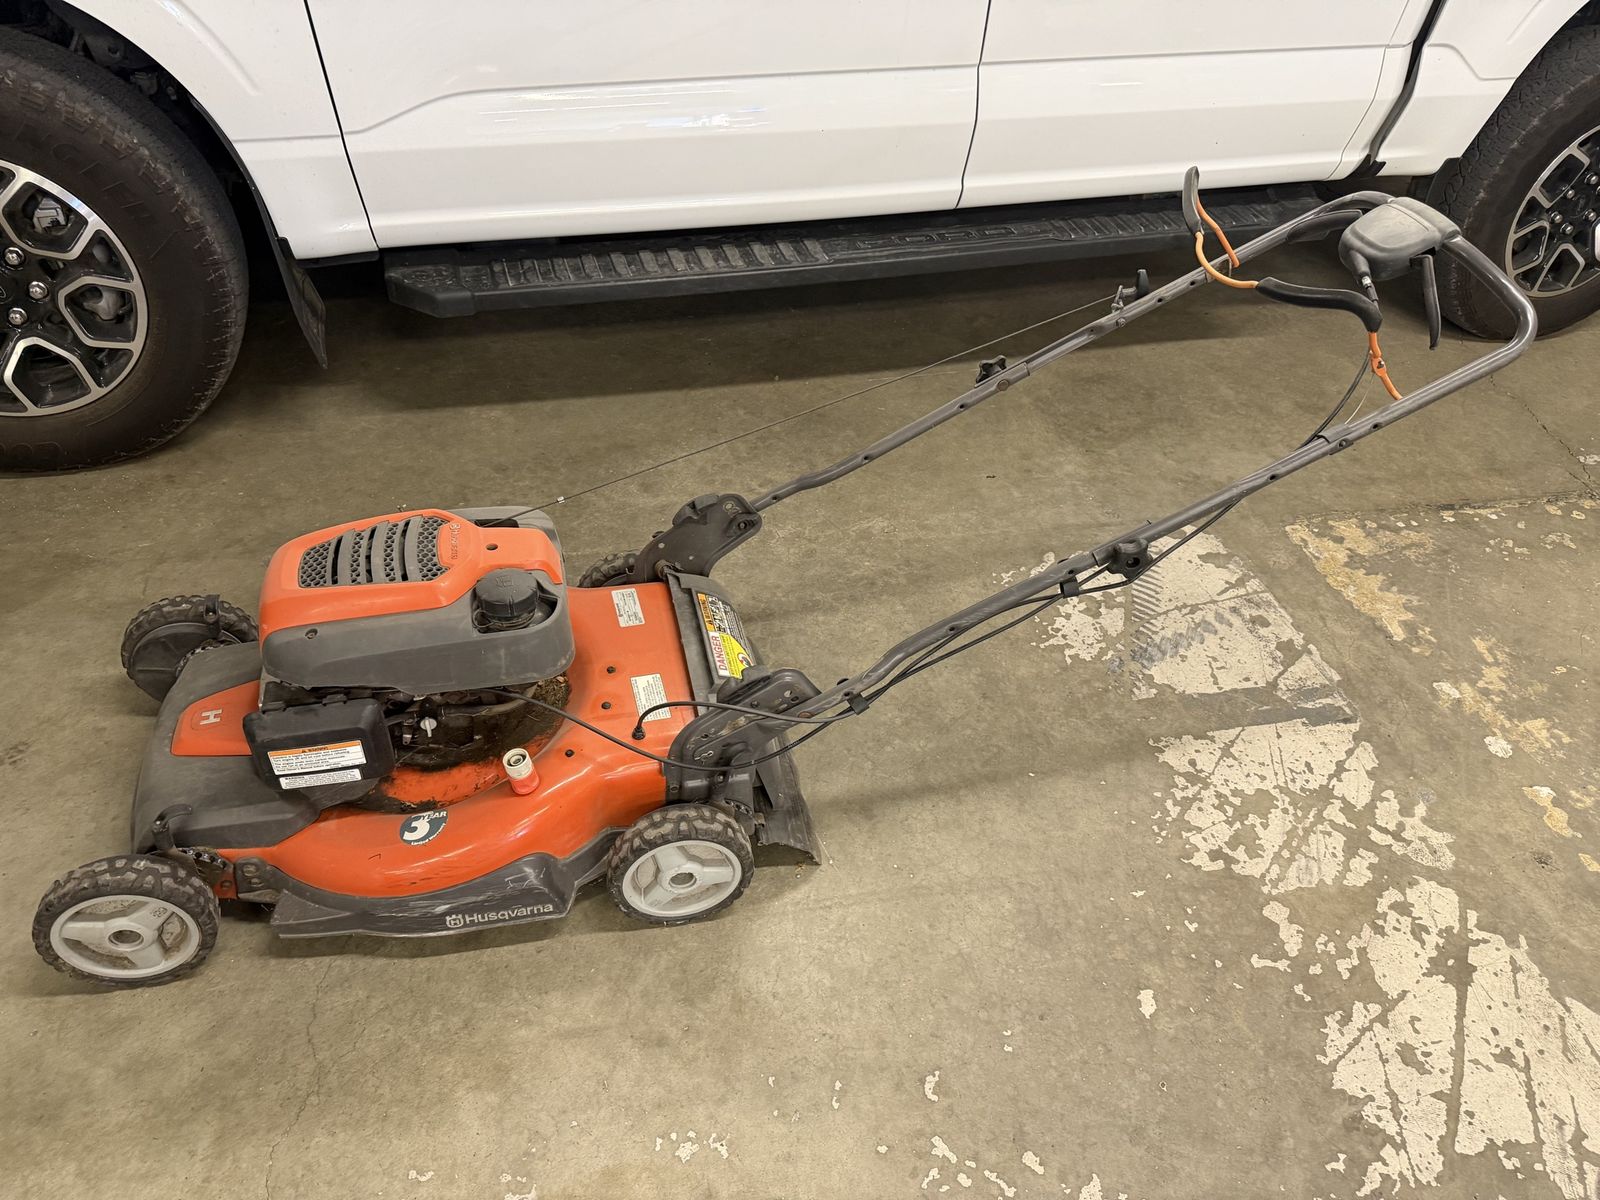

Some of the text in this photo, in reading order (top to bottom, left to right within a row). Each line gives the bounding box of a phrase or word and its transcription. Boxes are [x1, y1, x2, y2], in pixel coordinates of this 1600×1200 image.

[711, 635, 728, 671] DANGER
[200, 709, 223, 725] H
[465, 903, 554, 924] Husqvarna
